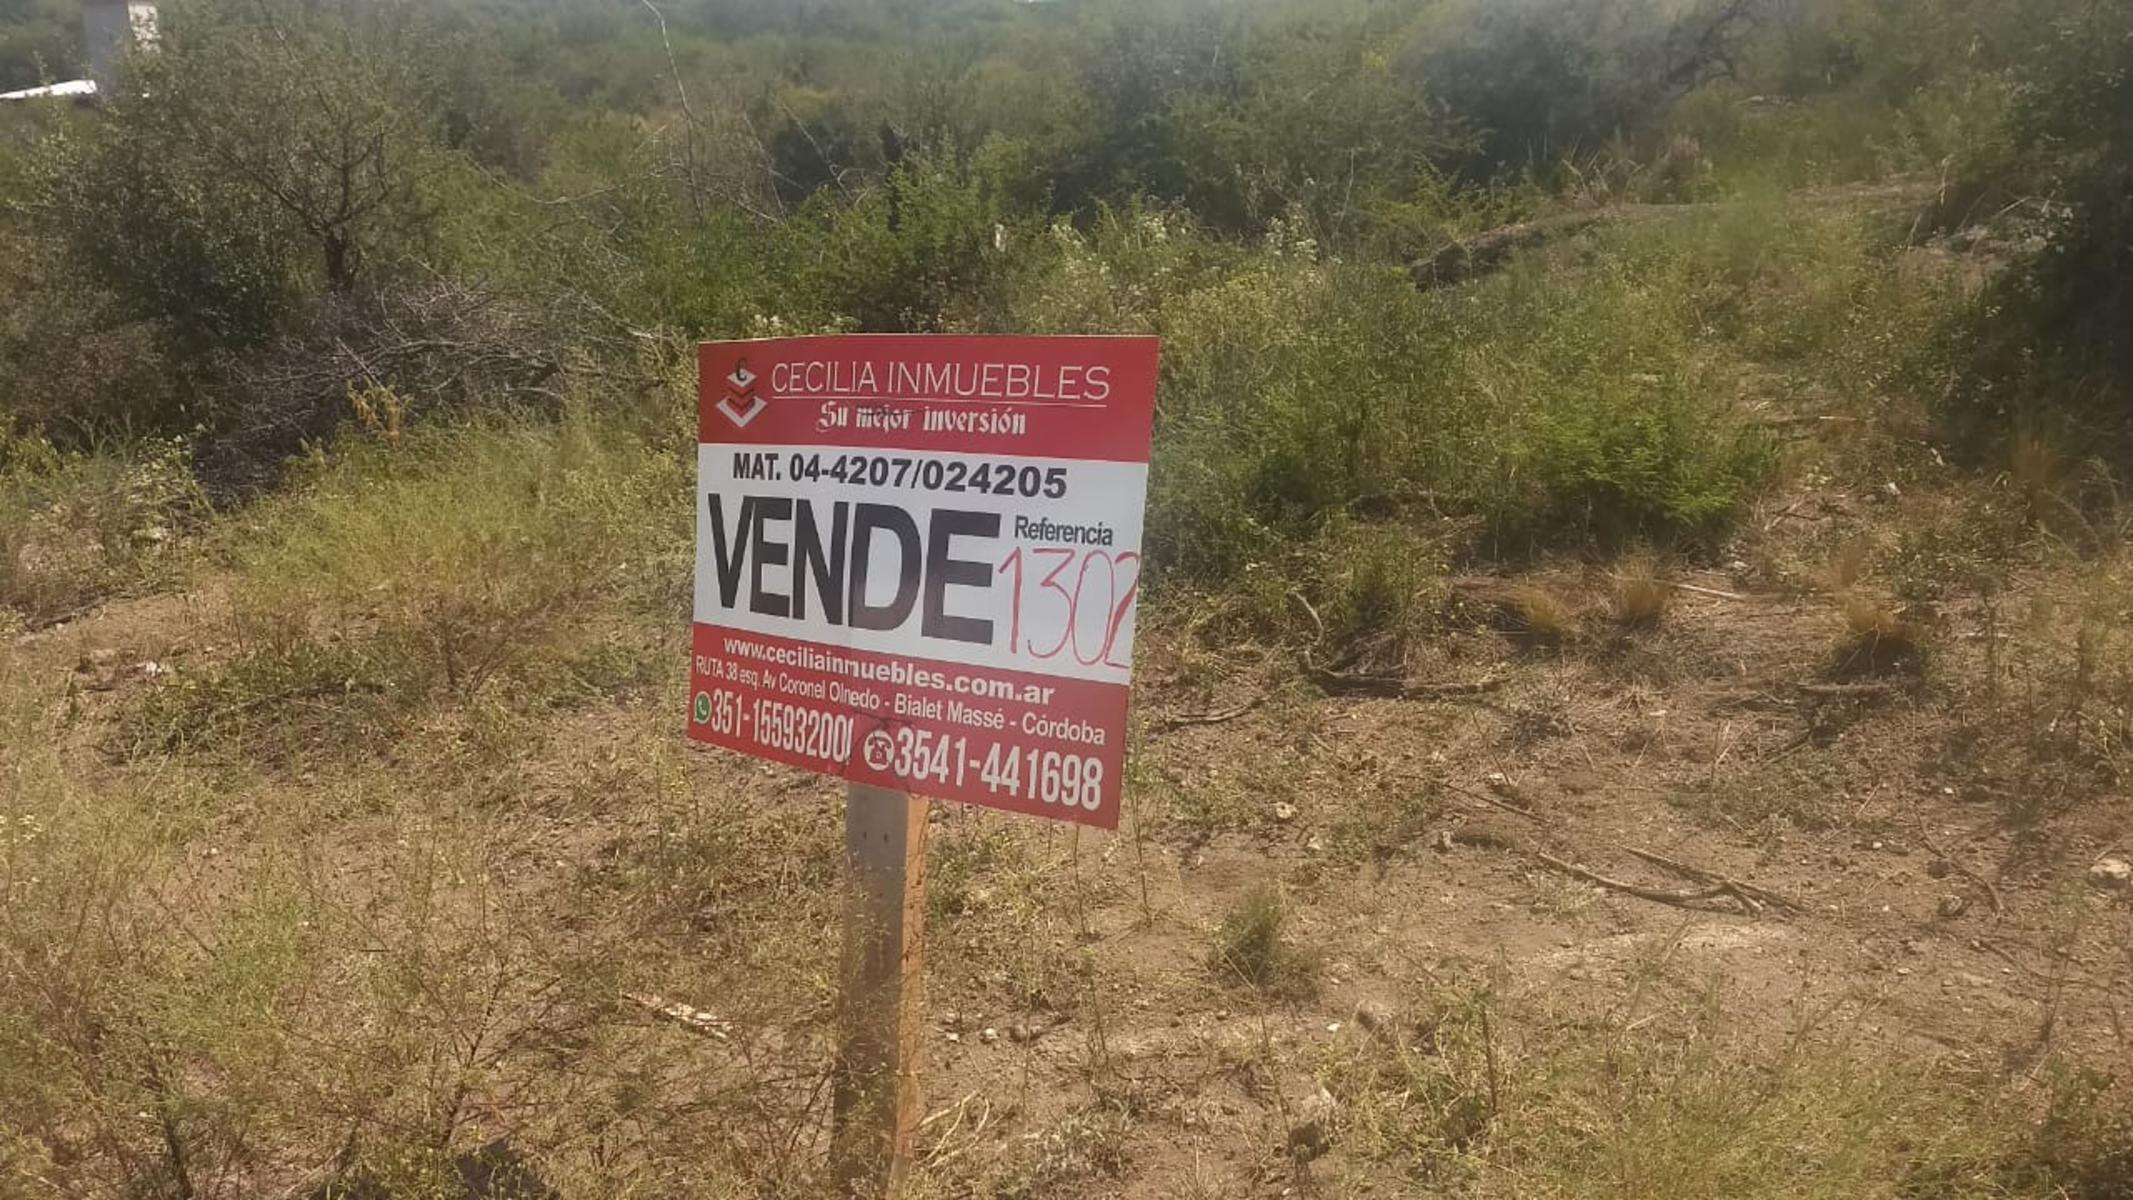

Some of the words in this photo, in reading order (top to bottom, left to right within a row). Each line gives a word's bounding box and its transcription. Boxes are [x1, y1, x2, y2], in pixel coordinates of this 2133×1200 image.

[770, 361, 878, 394] CECILIA
[887, 361, 1112, 400] INMUEBLES
[815, 400, 849, 433] Su
[856, 403, 914, 433] mejor
[922, 405, 1027, 435] inversión
[732, 452, 781, 482] MAT.
[789, 453, 1068, 500] 04-4207/024205
[1014, 515, 1114, 547] Referencia
[707, 492, 1001, 646] VENDE
[997, 546, 1142, 670] 1302
[695, 654, 724, 679] RUTA
[726, 661, 738, 681] 38
[779, 672, 826, 699] Coronel
[894, 693, 943, 721] Bialet
[946, 701, 1005, 730] Massé
[1022, 711, 1107, 746] Córdoba
[723, 638, 1056, 705] www.ceciliainmuebles.com.ar
[893, 725, 1105, 812] 3541-441698
